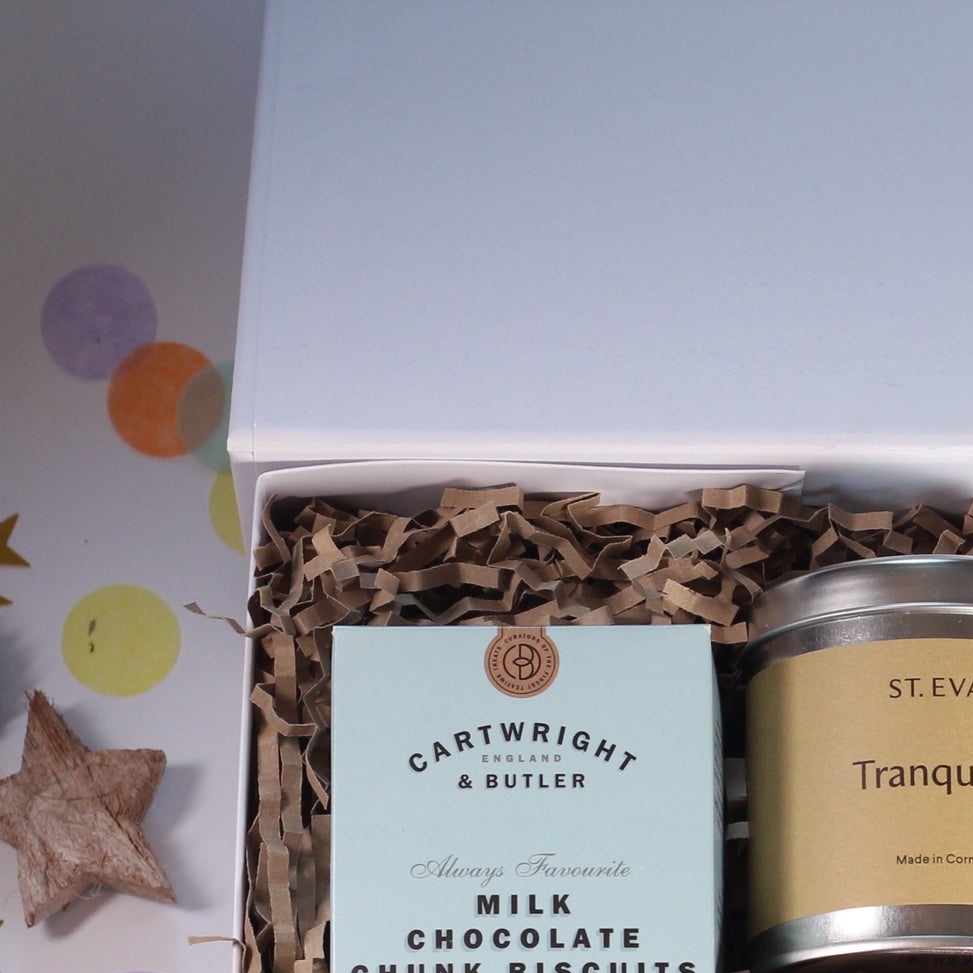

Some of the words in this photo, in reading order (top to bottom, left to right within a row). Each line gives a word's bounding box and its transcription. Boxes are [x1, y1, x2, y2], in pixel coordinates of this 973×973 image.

[889, 678, 924, 699] ST.
[408, 721, 638, 773] CARTWRIGHT
[481, 754, 563, 763] ENGLAND
[458, 774, 473, 788] &
[486, 773, 586, 788] BUTLER
[896, 854, 930, 865] Made
[932, 853, 943, 864] in
[410, 854, 504, 887] Always
[514, 853, 632, 878] Favourite
[477, 894, 571, 914] MILK
[407, 928, 641, 950] CHOCOLATE
